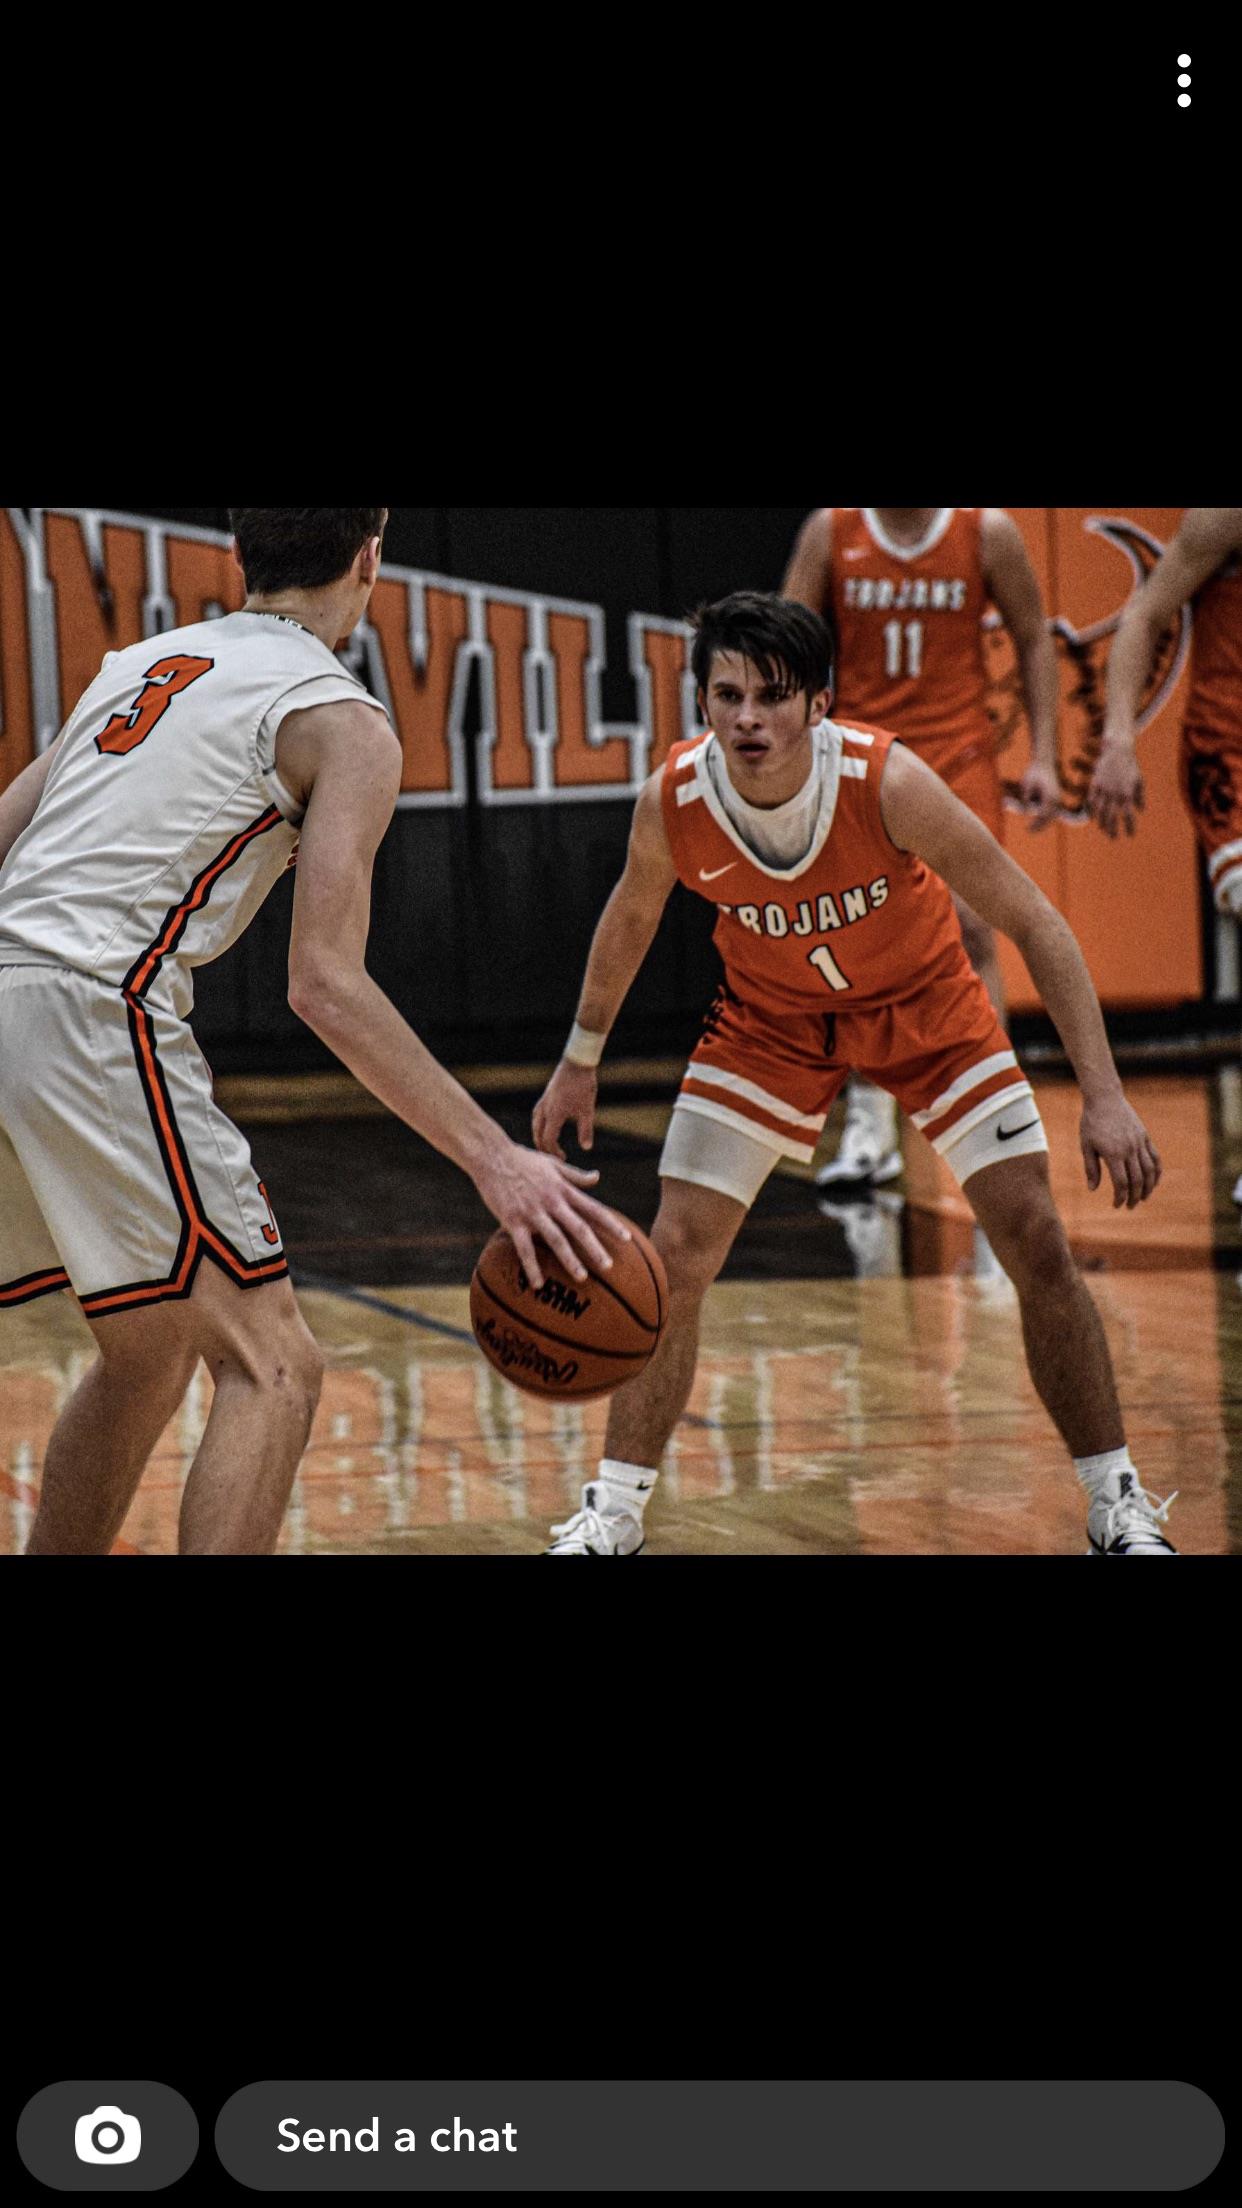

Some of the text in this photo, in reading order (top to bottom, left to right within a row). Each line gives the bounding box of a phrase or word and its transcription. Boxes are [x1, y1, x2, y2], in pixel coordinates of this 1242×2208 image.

[884, 617, 923, 679] 11
[93, 654, 215, 756] 3
[717, 875, 890, 938] ROJANS
[806, 944, 854, 992] 1
